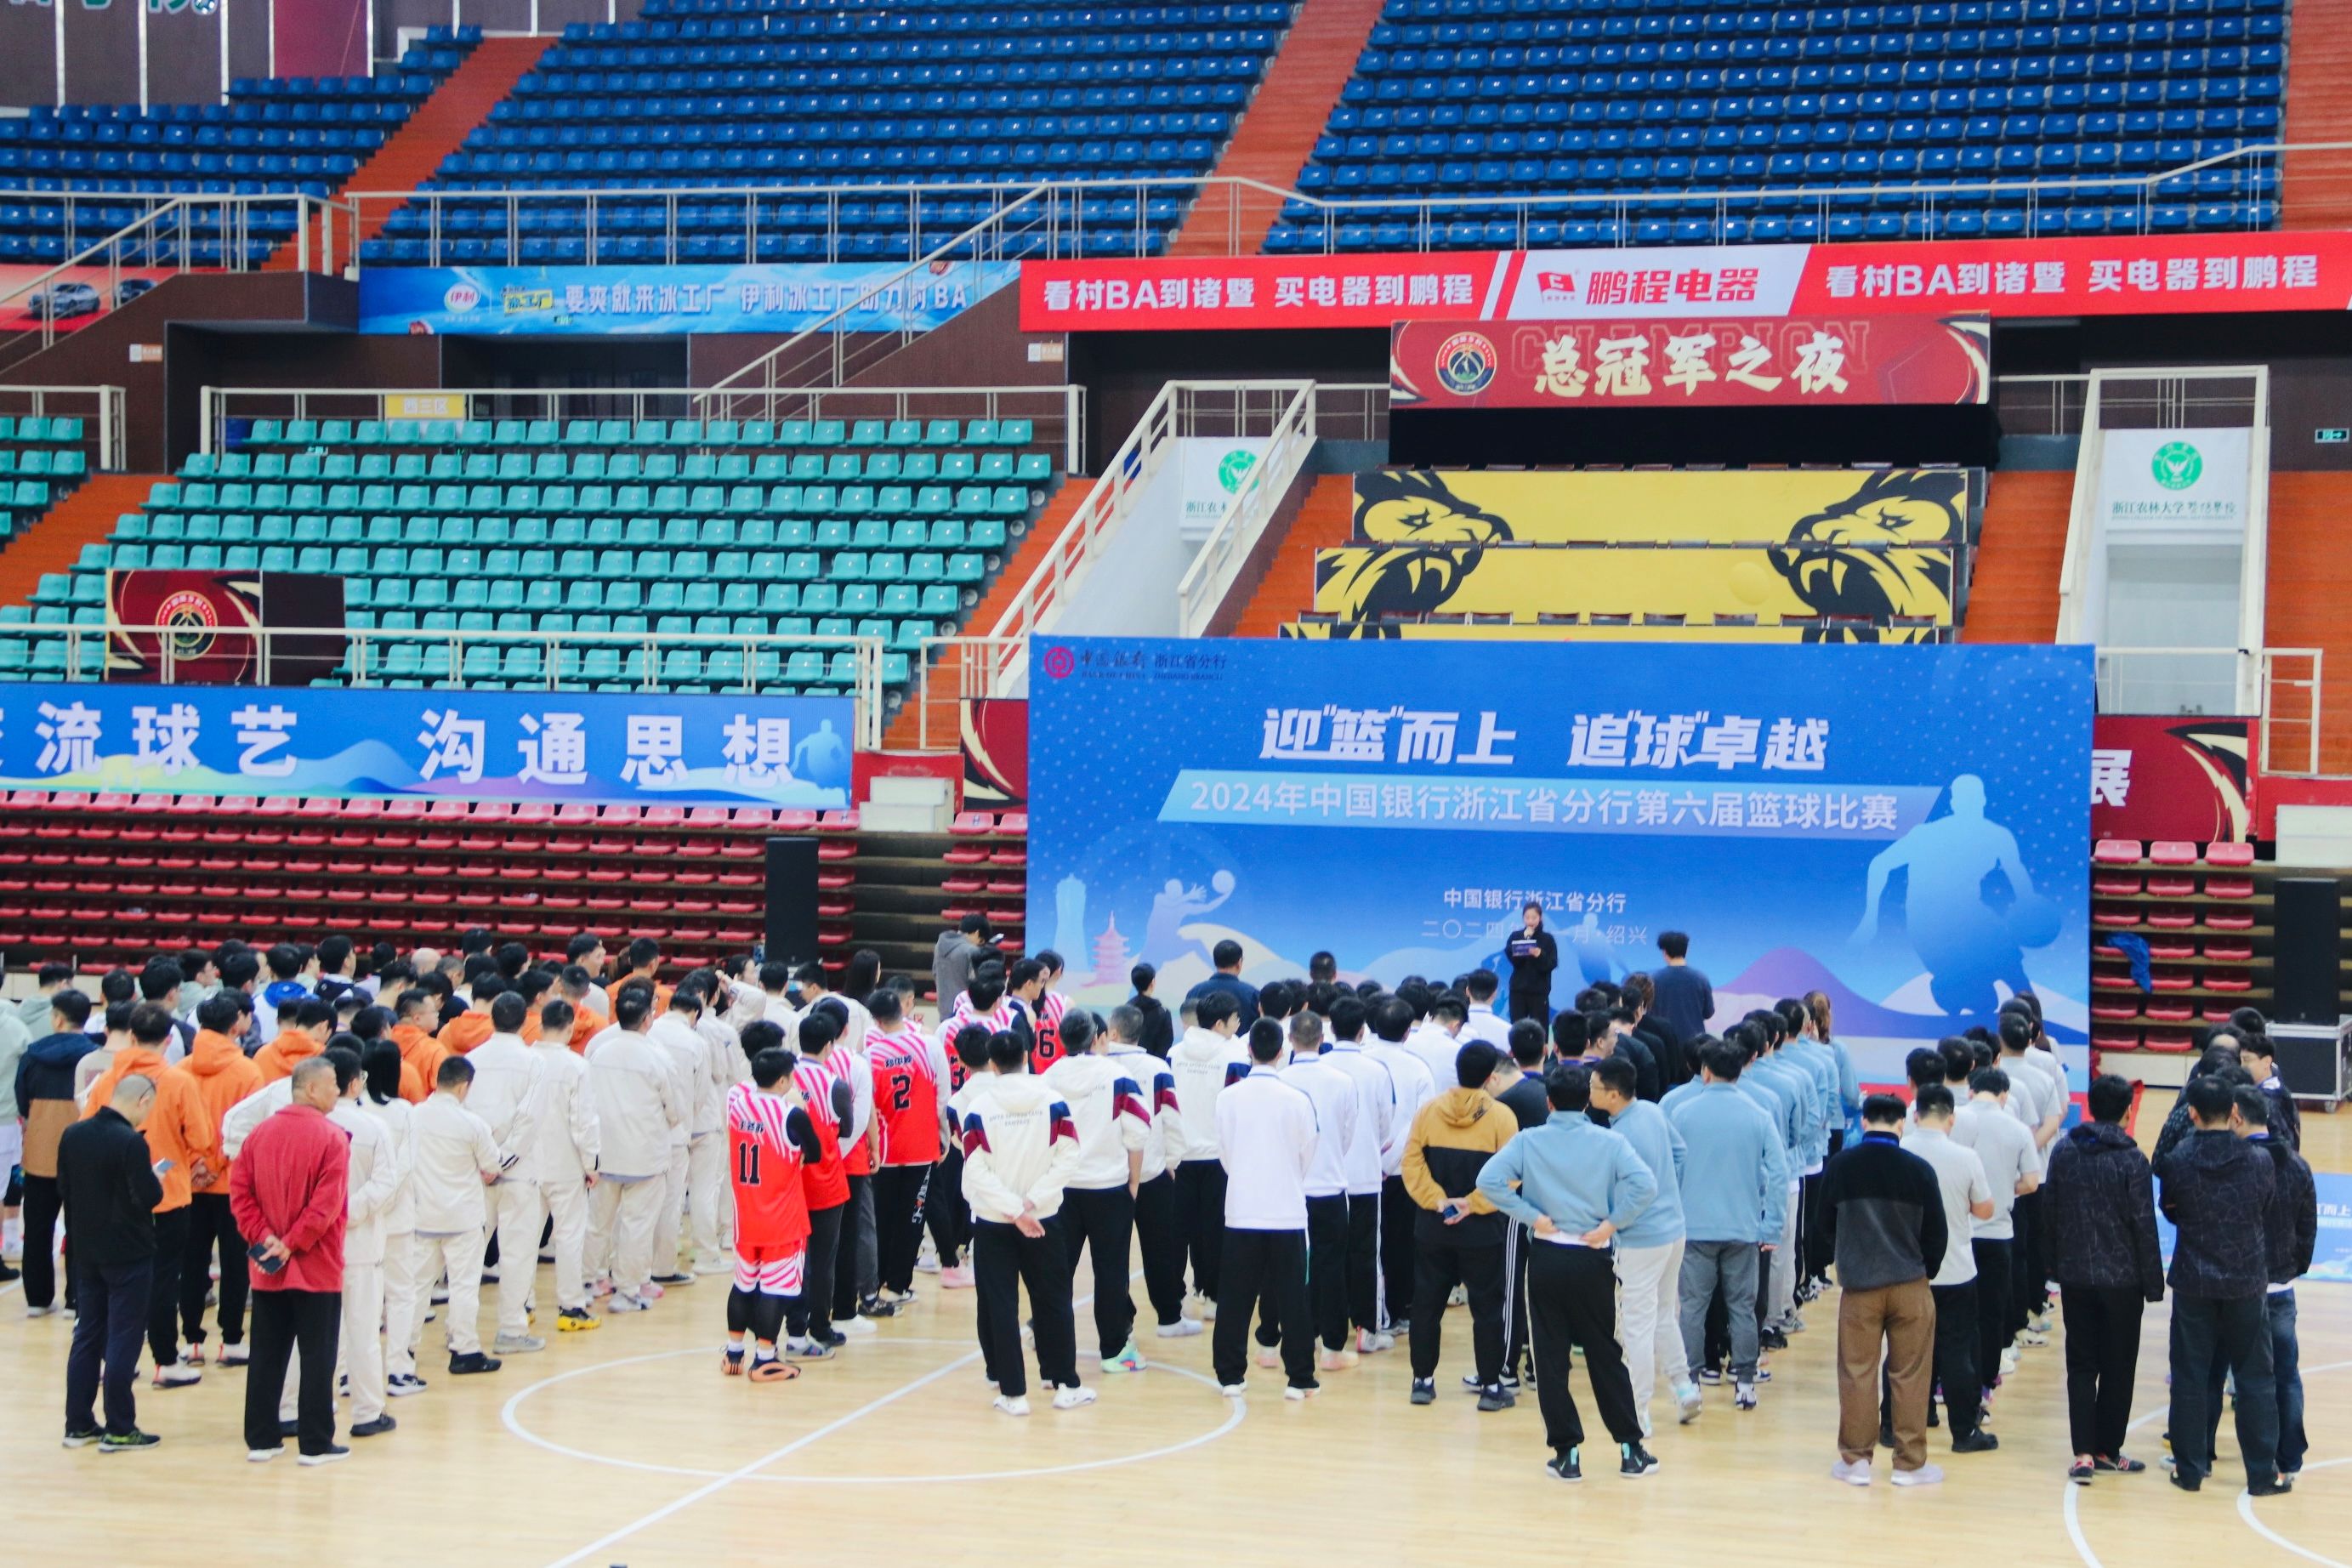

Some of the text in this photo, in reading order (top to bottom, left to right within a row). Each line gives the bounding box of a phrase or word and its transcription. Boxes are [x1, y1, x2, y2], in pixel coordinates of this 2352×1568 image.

[1044, 274, 1473, 310] 看村BA到诸暨 买电器到鹏程
[1585, 268, 1759, 305] 鹏程电器
[1826, 255, 2317, 298] 看村BA到诸暨 买电器到鹏程
[450, 292, 474, 303] 伊利
[565, 284, 725, 314] 要爽就来冰工厂
[1534, 331, 1849, 398] 总冠军之夜
[0, 701, 793, 789] 流球艺 沟通思想
[1190, 780, 1898, 831] 2024年中国银行浙江省分行第六届篮球比赛
[1039, 1029, 1054, 1058] 6
[892, 1075, 911, 1111] 2
[739, 1142, 760, 1185] 11
